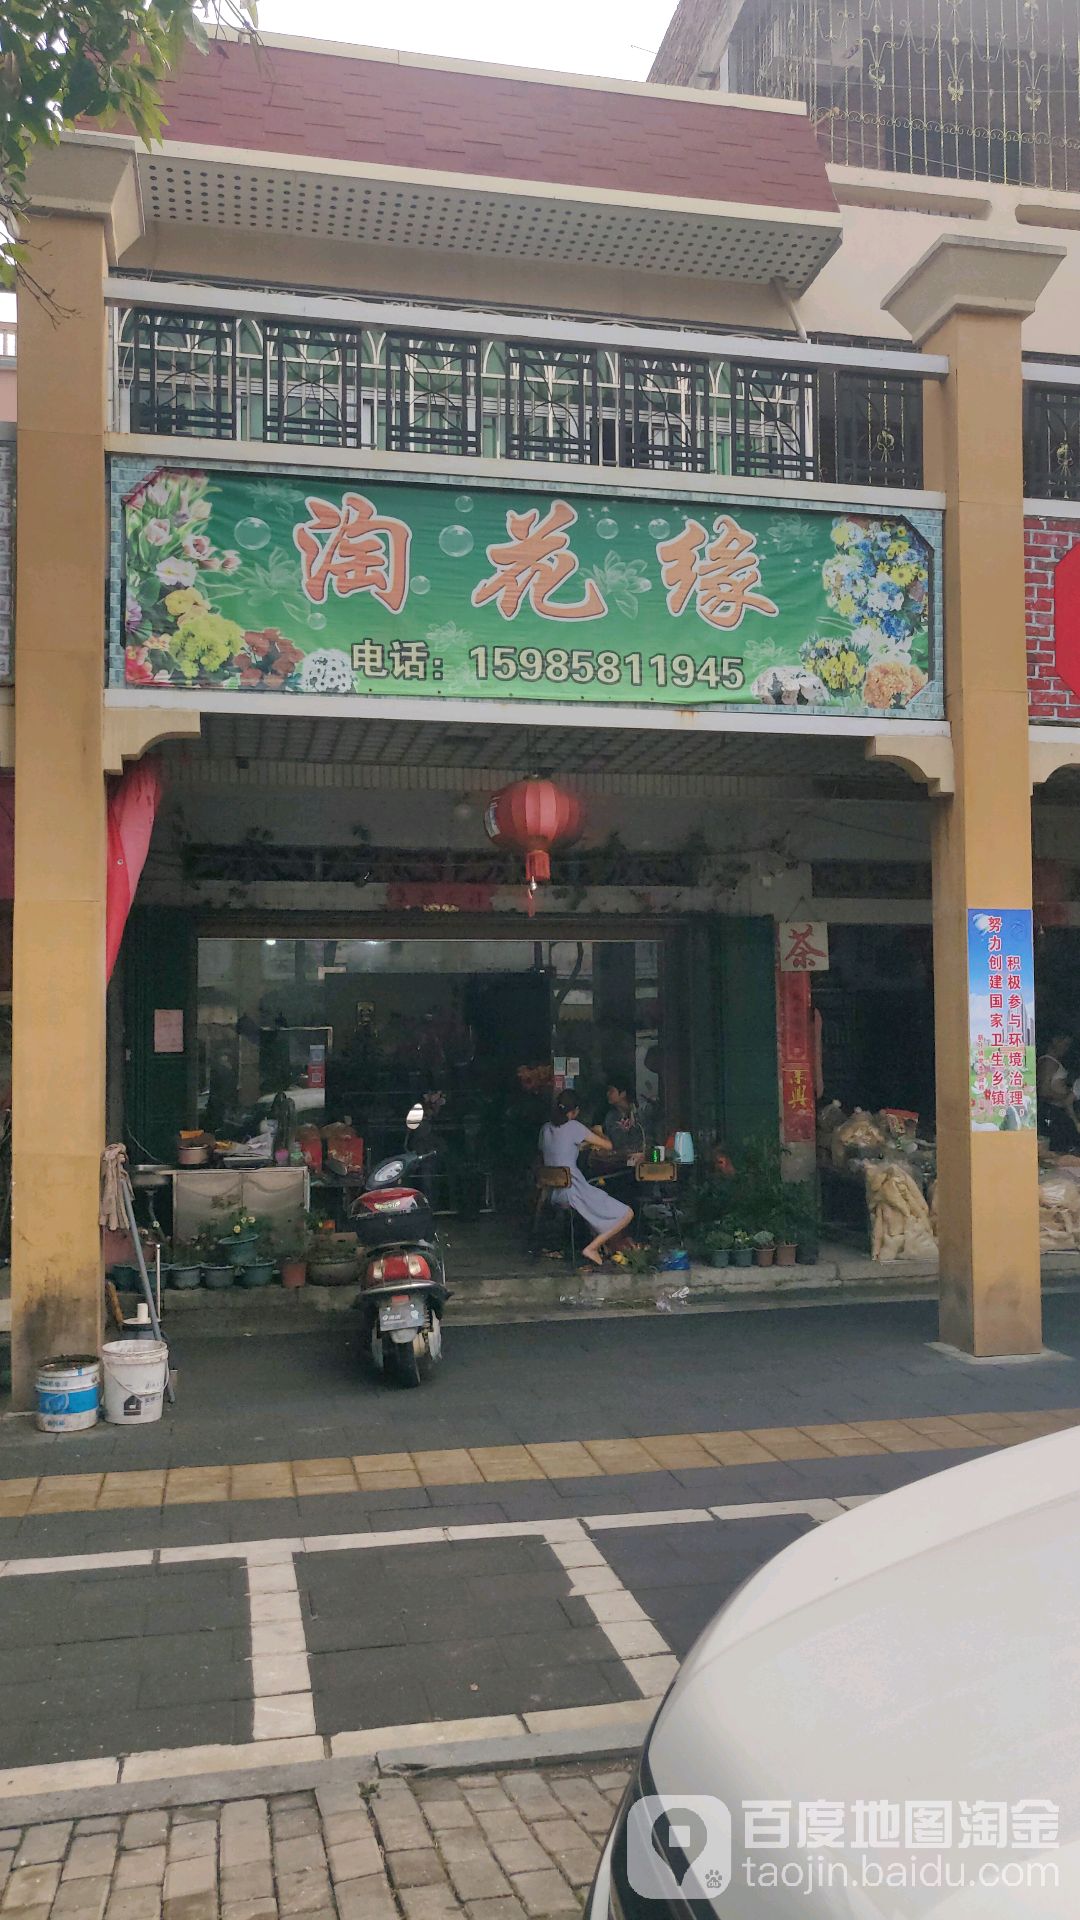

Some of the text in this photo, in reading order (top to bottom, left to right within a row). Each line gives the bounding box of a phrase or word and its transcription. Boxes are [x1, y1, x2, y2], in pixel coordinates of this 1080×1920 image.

[293, 492, 780, 631] 淘花缘
[469, 644, 745, 690] 15985811945
[785, 923, 827, 968] 茶
